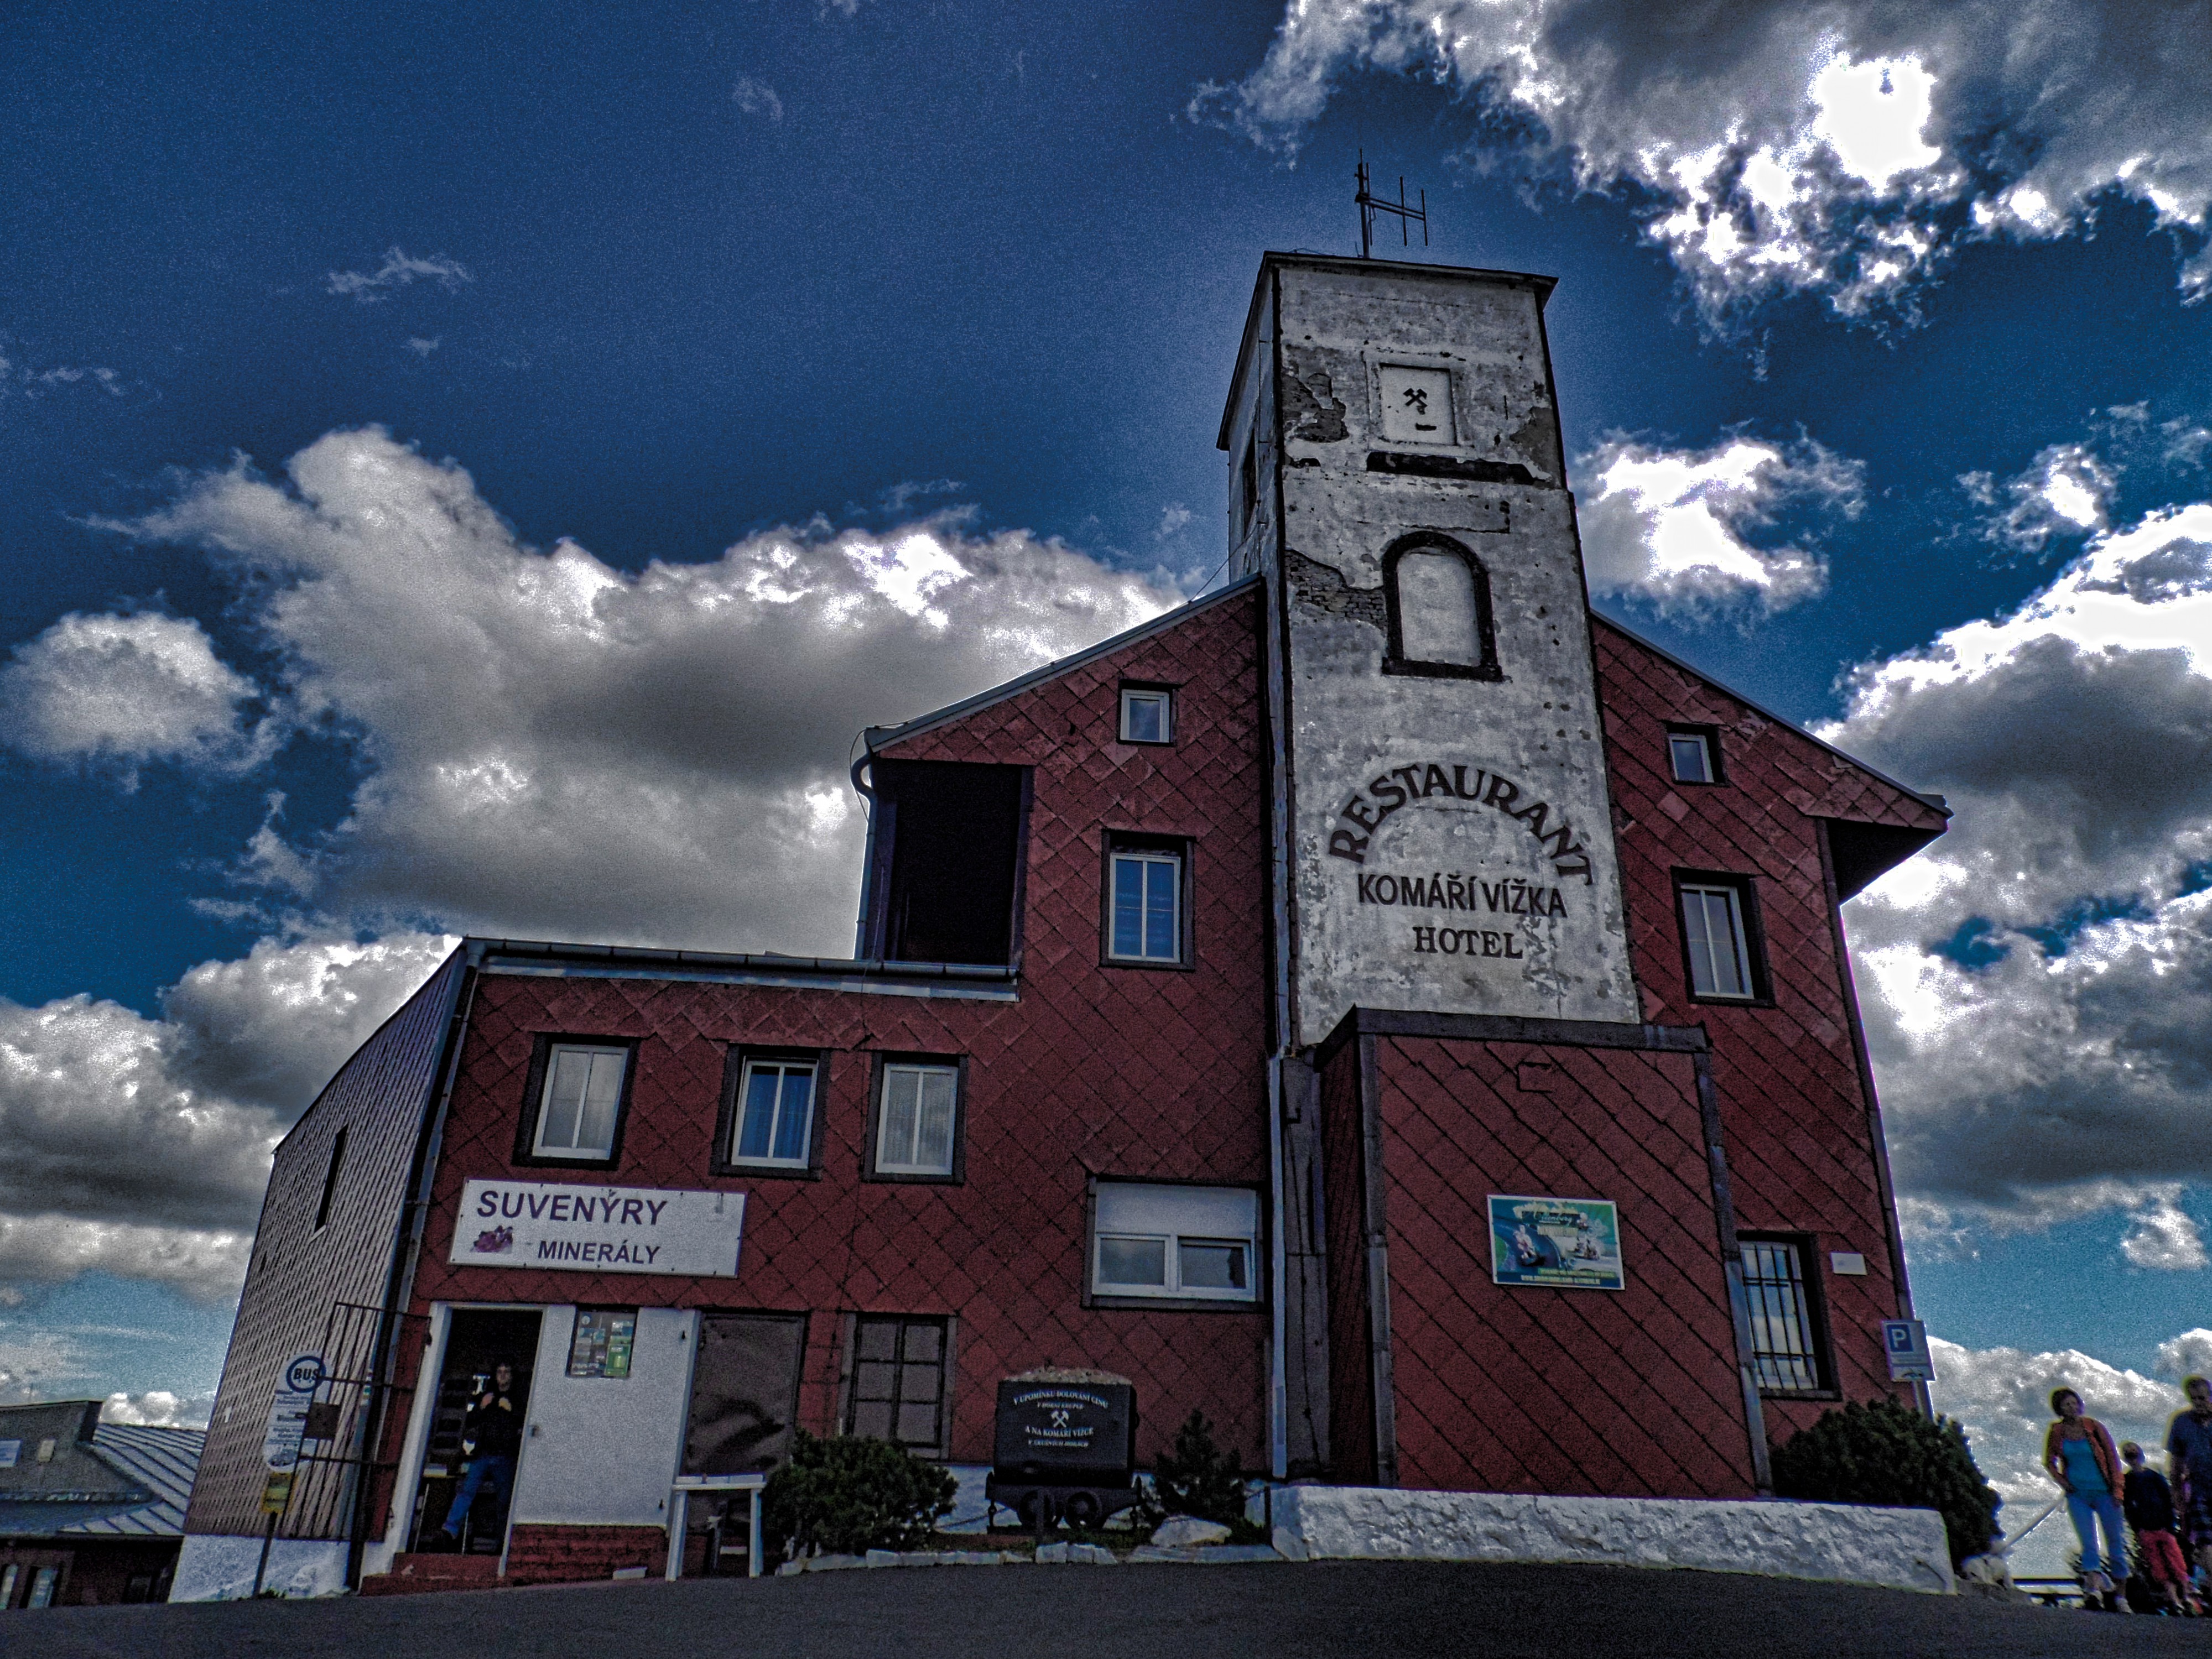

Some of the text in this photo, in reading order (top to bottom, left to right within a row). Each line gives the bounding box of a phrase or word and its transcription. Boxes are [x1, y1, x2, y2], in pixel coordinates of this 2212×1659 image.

[1329, 764, 1594, 885] RESTAURANT
[1358, 873, 1568, 918] KOMÁŘÍ VÍŽKA
[1412, 926, 1523, 959] HOTEL
[477, 1189, 668, 1226] SUVENÝRY
[537, 1239, 662, 1265] MINERÁLY
[1891, 1328, 1907, 1348] P
[294, 1368, 319, 1381] BUS
